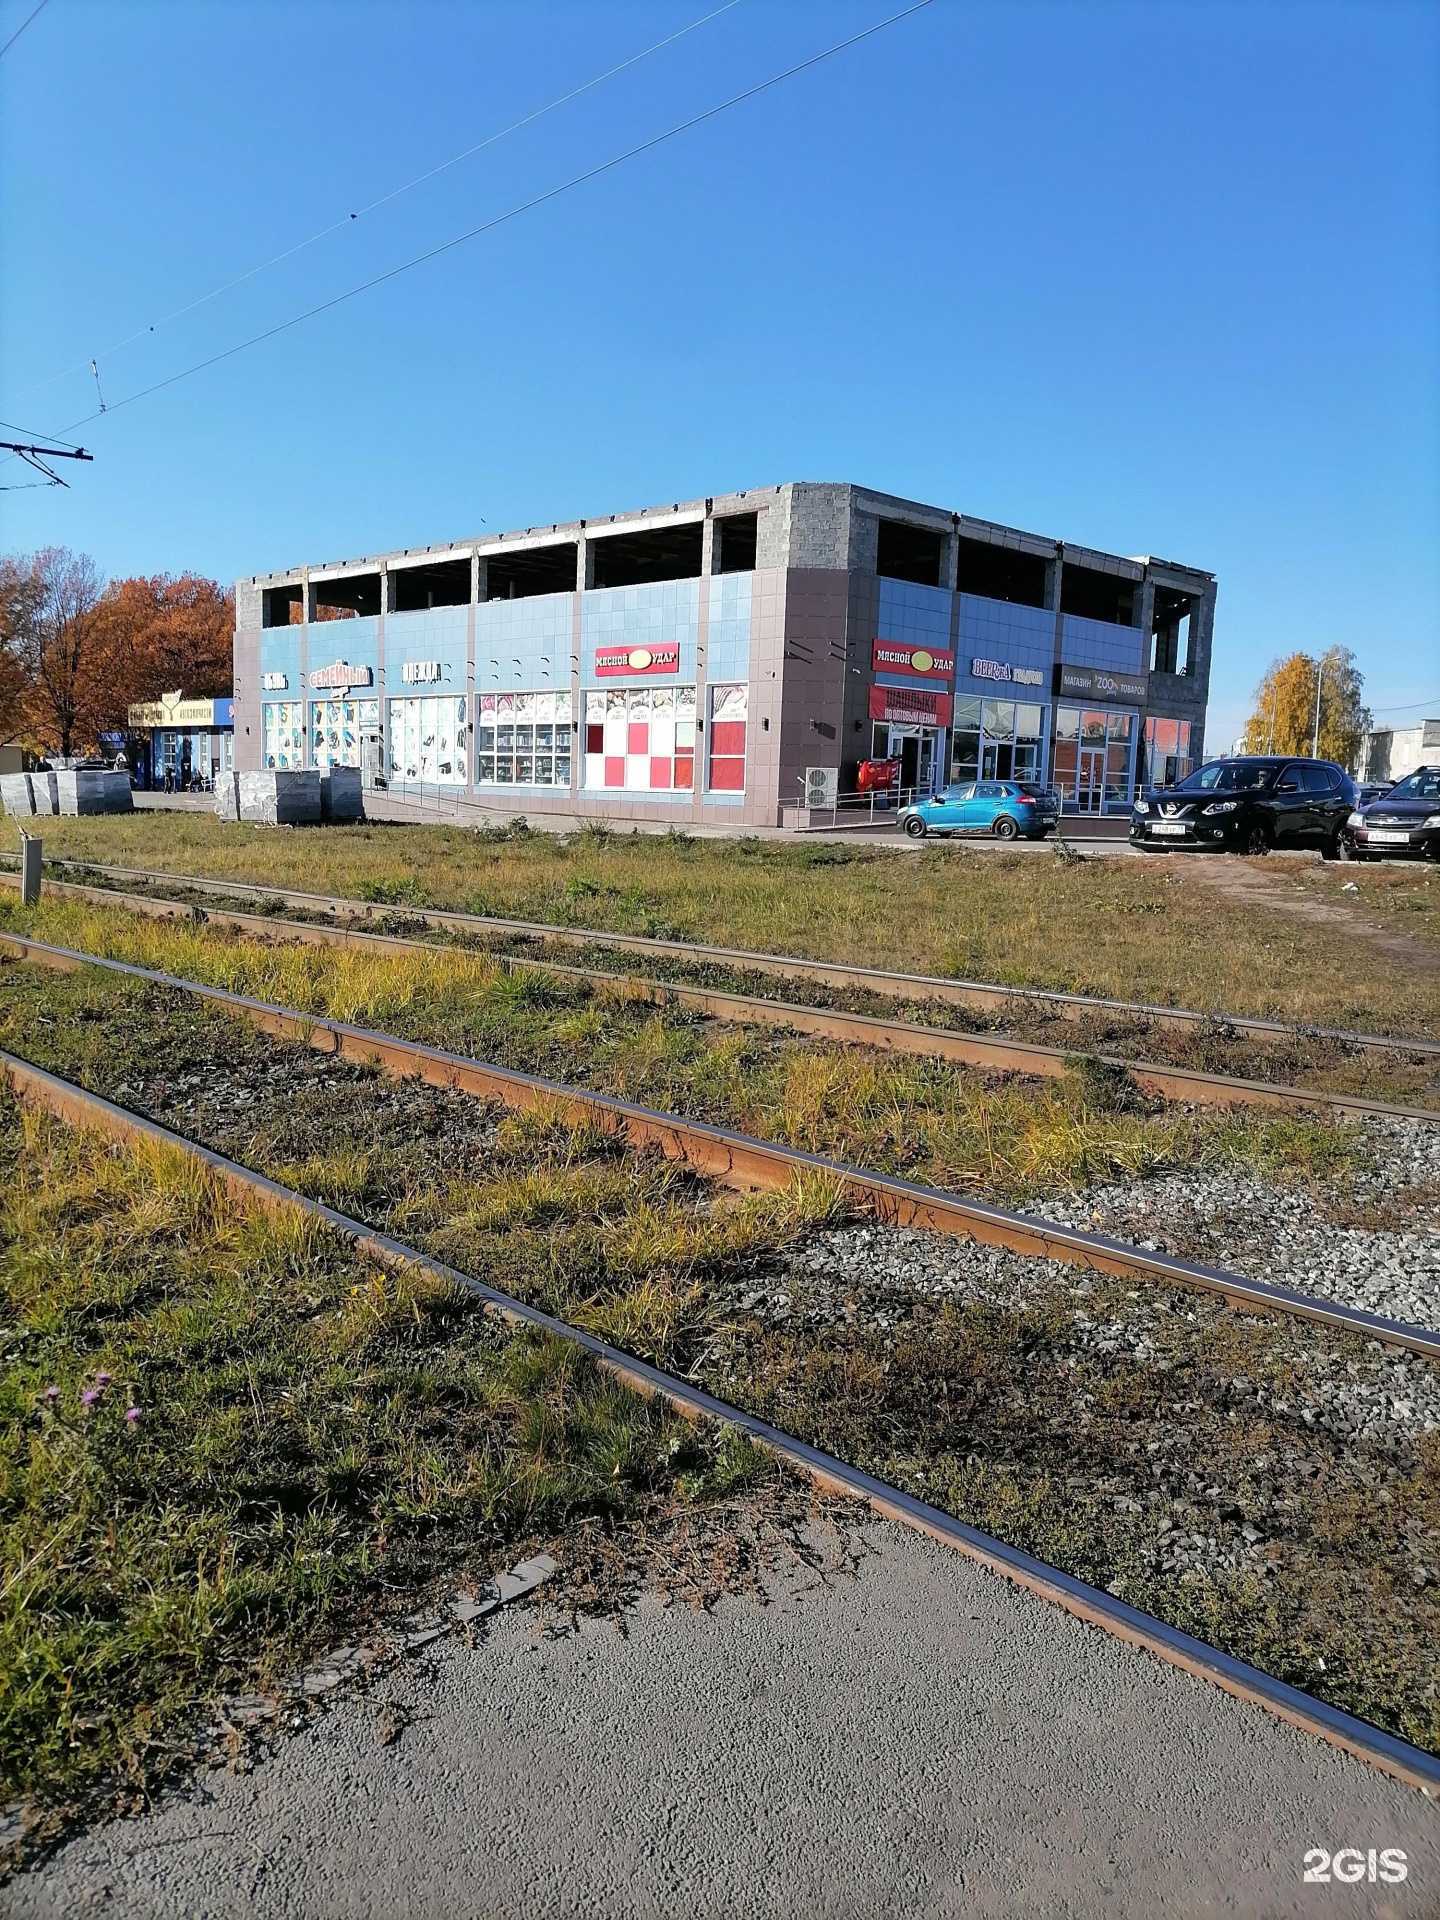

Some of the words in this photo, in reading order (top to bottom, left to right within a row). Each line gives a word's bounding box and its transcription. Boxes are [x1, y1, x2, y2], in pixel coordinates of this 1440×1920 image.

[596, 653, 629, 667] МЯСНОЙ
[652, 652, 675, 666] УДАР
[877, 649, 911, 665] МЯСНОЙ
[933, 657, 954, 672] УДАР
[1064, 675, 1092, 689] МАГАЗИН
[1120, 683, 1145, 696] ТОВАРОВ
[886, 690, 937, 713] ШАШЛЫКИ
[884, 708, 893, 720] ПО
[893, 709, 918, 723] ОПТОВЫМ
[919, 711, 937, 725] ЦЕНАМ
